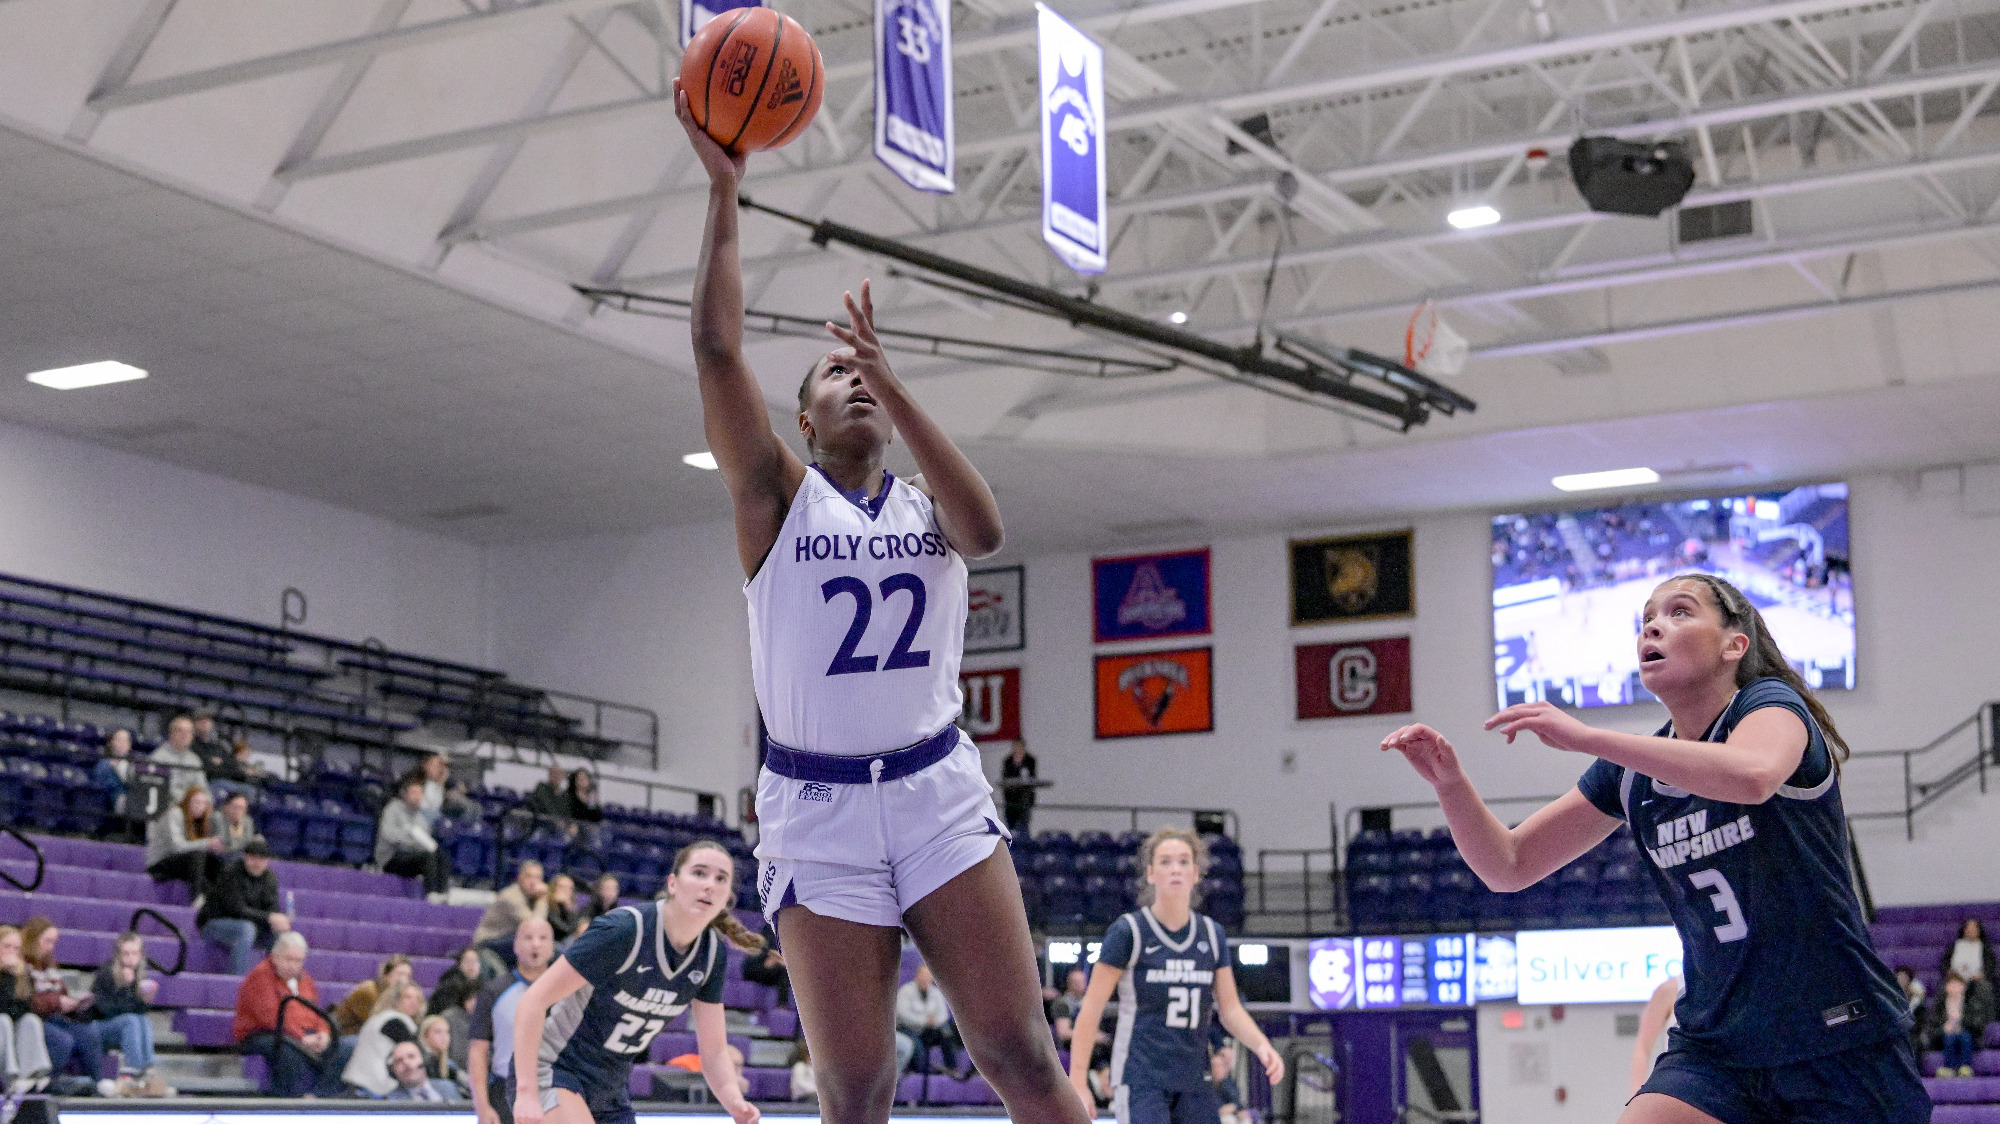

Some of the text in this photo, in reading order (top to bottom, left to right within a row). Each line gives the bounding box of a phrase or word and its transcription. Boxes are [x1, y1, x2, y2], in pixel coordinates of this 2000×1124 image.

[897, 16, 931, 63] 33
[795, 533, 947, 562] HOLY CROSS
[821, 572, 931, 676] 22
[1330, 646, 1377, 711] C
[798, 795, 833, 803] LEAGUE
[799, 790, 832, 798] PATRIOT
[1656, 809, 1708, 847] NEW
[1688, 868, 1748, 943] 3
[1165, 959, 1196, 971] NEW
[1530, 956, 1630, 982] Silver
[642, 987, 679, 1005] NEW
[1166, 987, 1201, 1030] 21
[603, 1012, 665, 1054] 23
